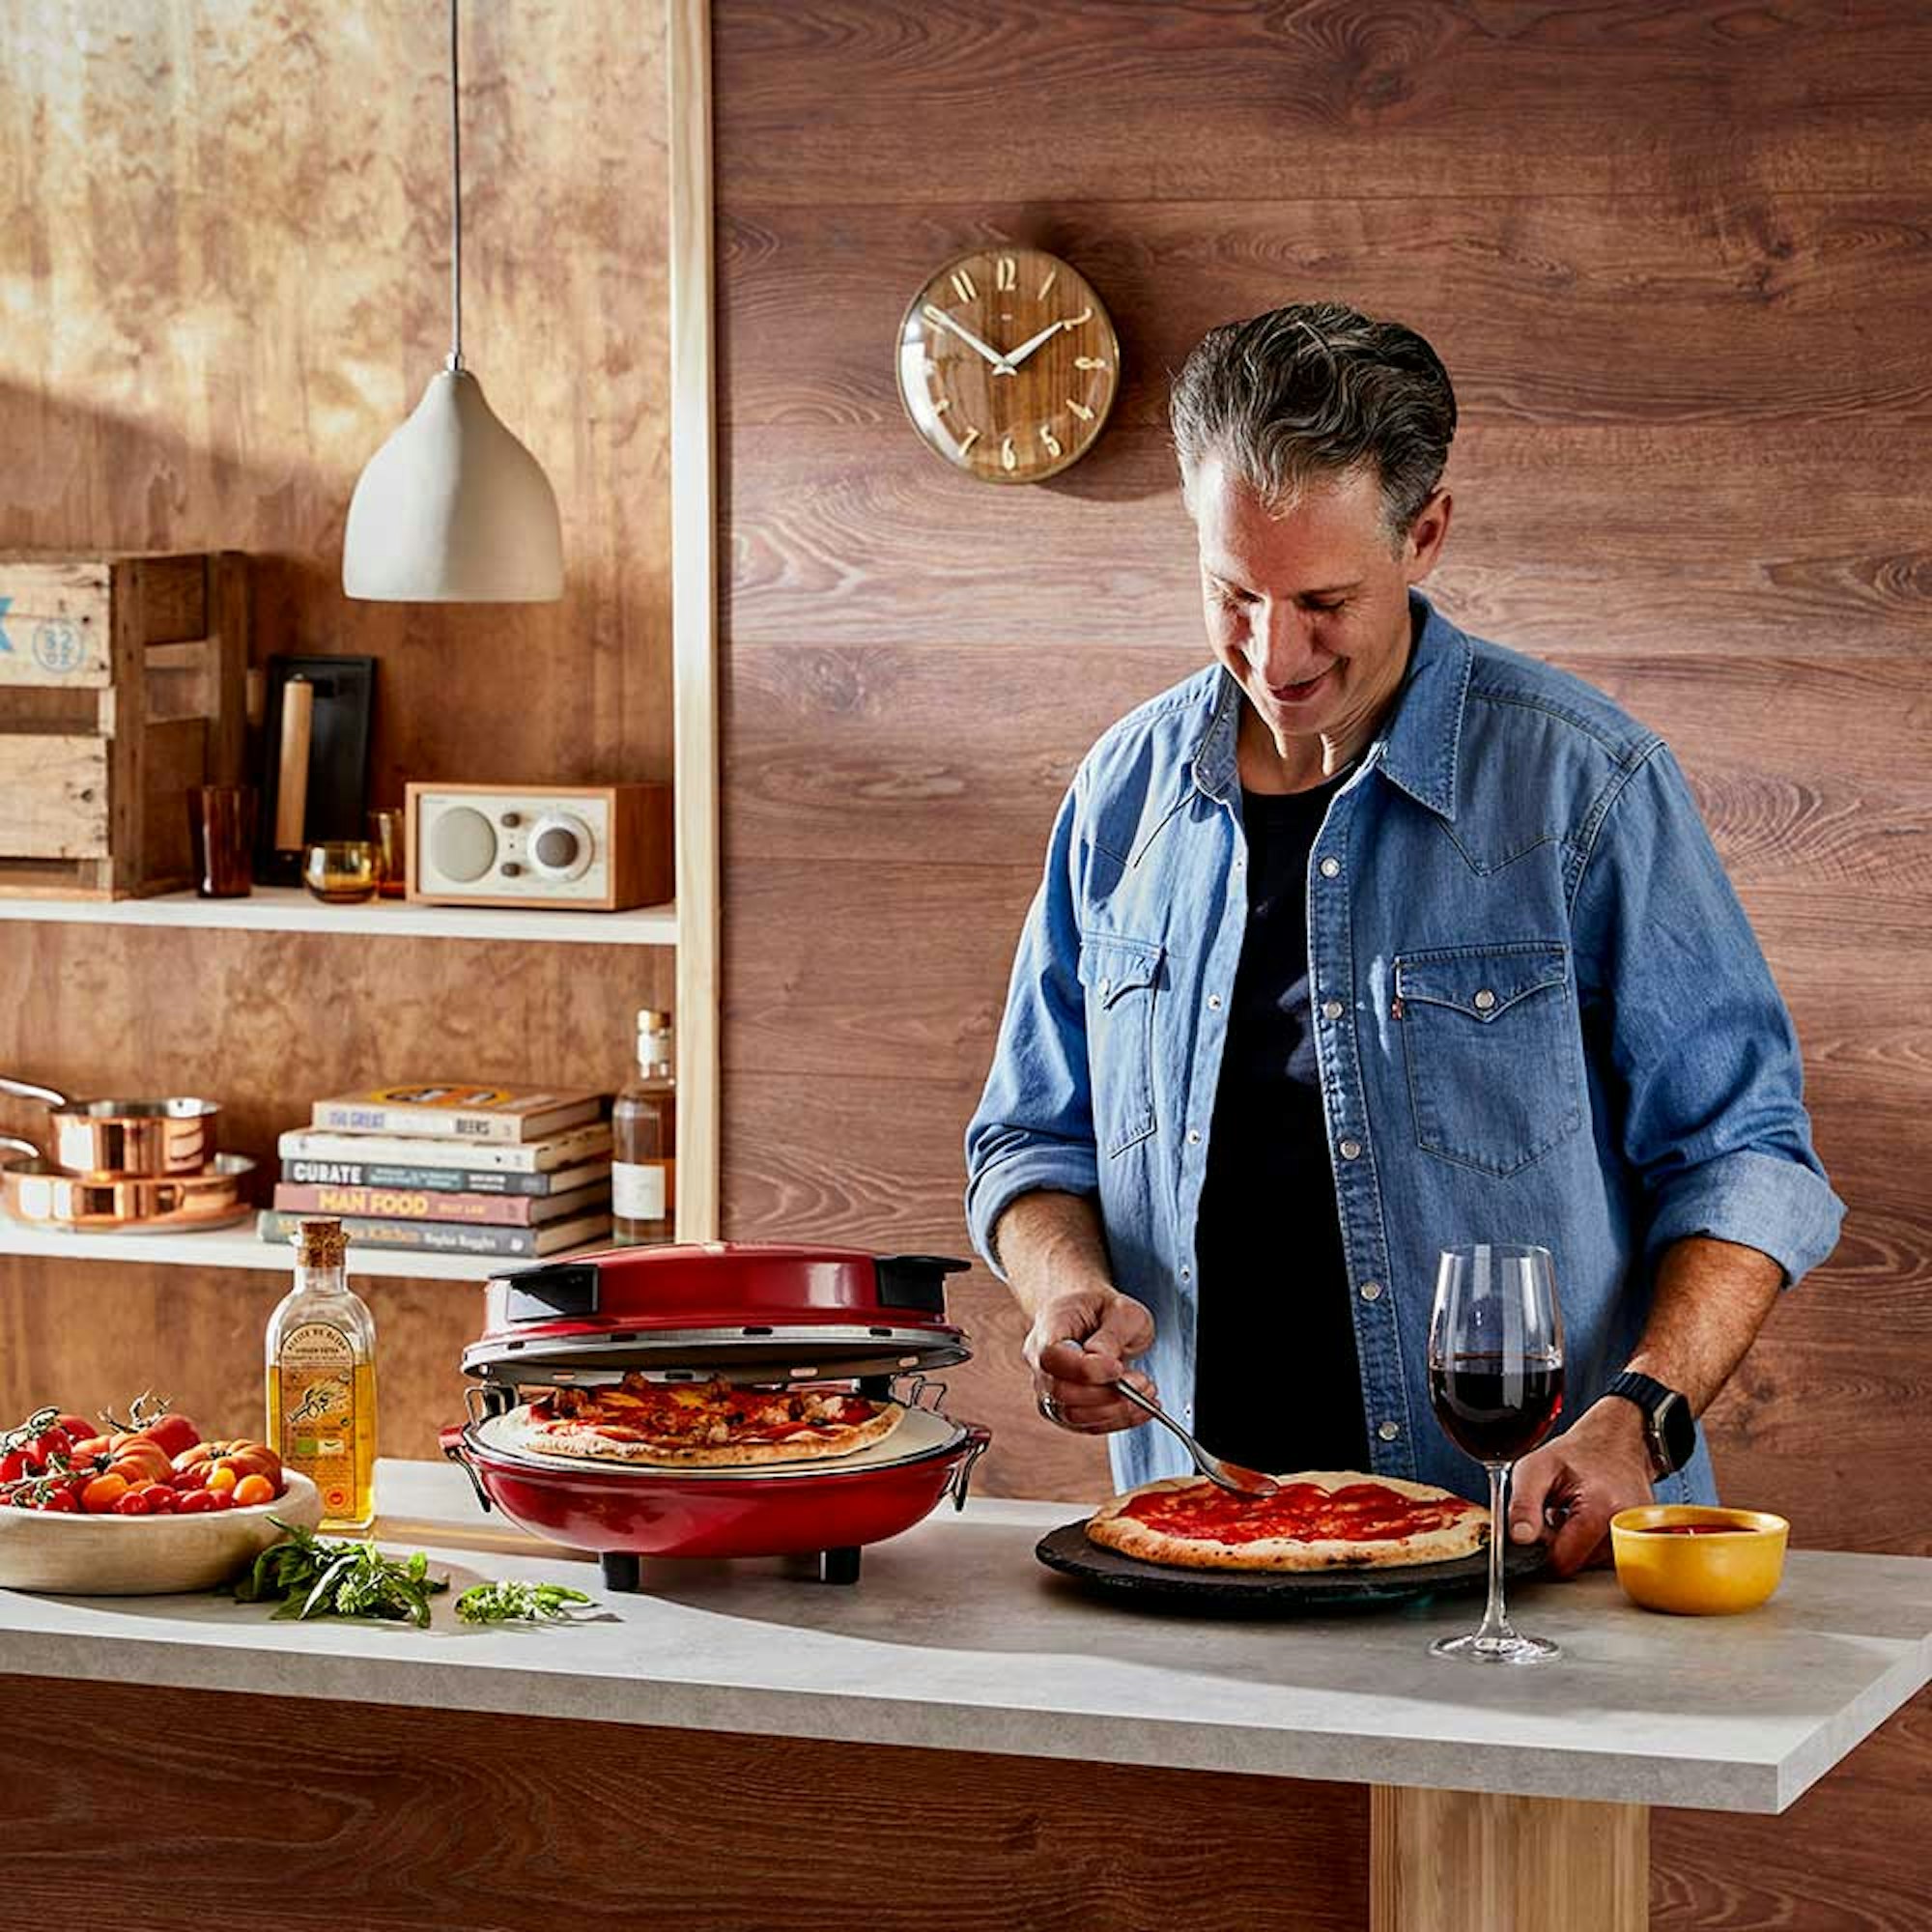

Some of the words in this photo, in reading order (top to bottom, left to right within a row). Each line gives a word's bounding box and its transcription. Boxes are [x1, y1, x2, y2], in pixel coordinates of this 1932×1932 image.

[951, 270, 978, 302] 11
[997, 258, 1015, 290] 12
[957, 425, 980, 457] 7
[1002, 438, 1015, 470] 6
[1040, 424, 1062, 457] 5
[456, 1118, 490, 1135] BEERS
[293, 1162, 362, 1184] CURATE
[319, 1190, 366, 1211] MAN
[370, 1192, 428, 1215] FOOD
